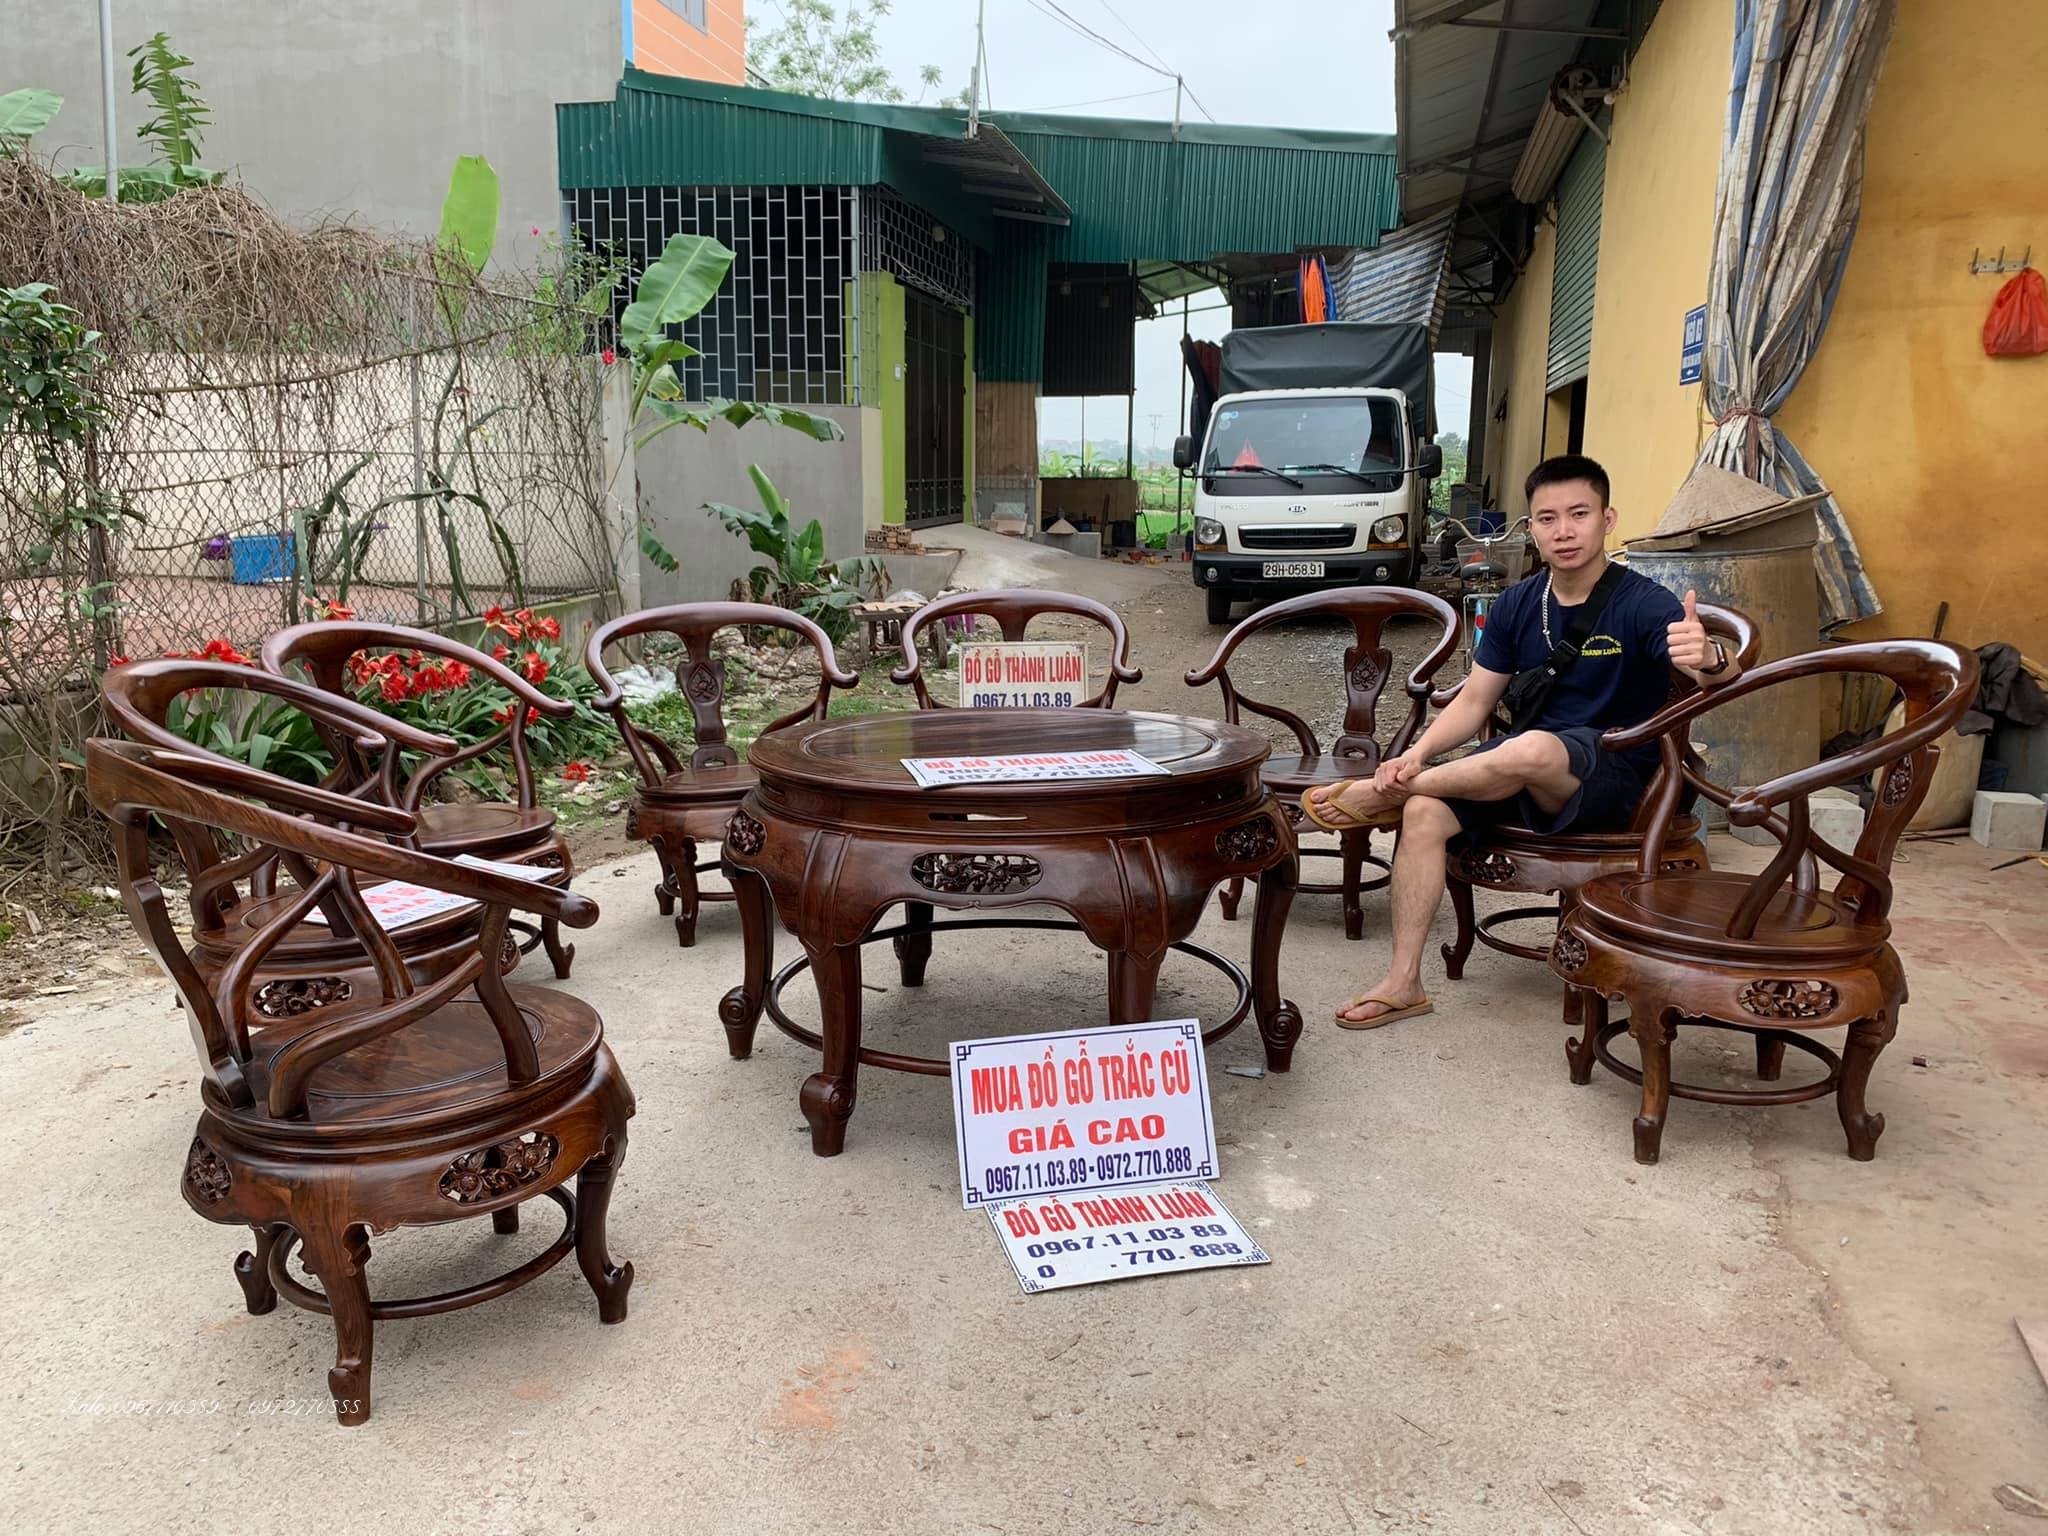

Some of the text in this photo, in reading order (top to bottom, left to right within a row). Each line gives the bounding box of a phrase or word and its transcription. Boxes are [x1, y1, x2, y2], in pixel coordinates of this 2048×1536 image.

[1264, 563, 1323, 576] 29H-058.91
[964, 650, 981, 683] ĐỒ
[1005, 651, 1046, 683] THÀNH
[1049, 651, 1081, 682] LUÂN
[973, 692, 1072, 707] 0967.11.03.89
[971, 1039, 1191, 1115] MUA ĐỒ GỖ TRẮC CŨ
[1008, 1114, 1166, 1154] GIÁ CAO
[1003, 1187, 1217, 1239] ĐỒ GỖ THÀNH LUÂN
